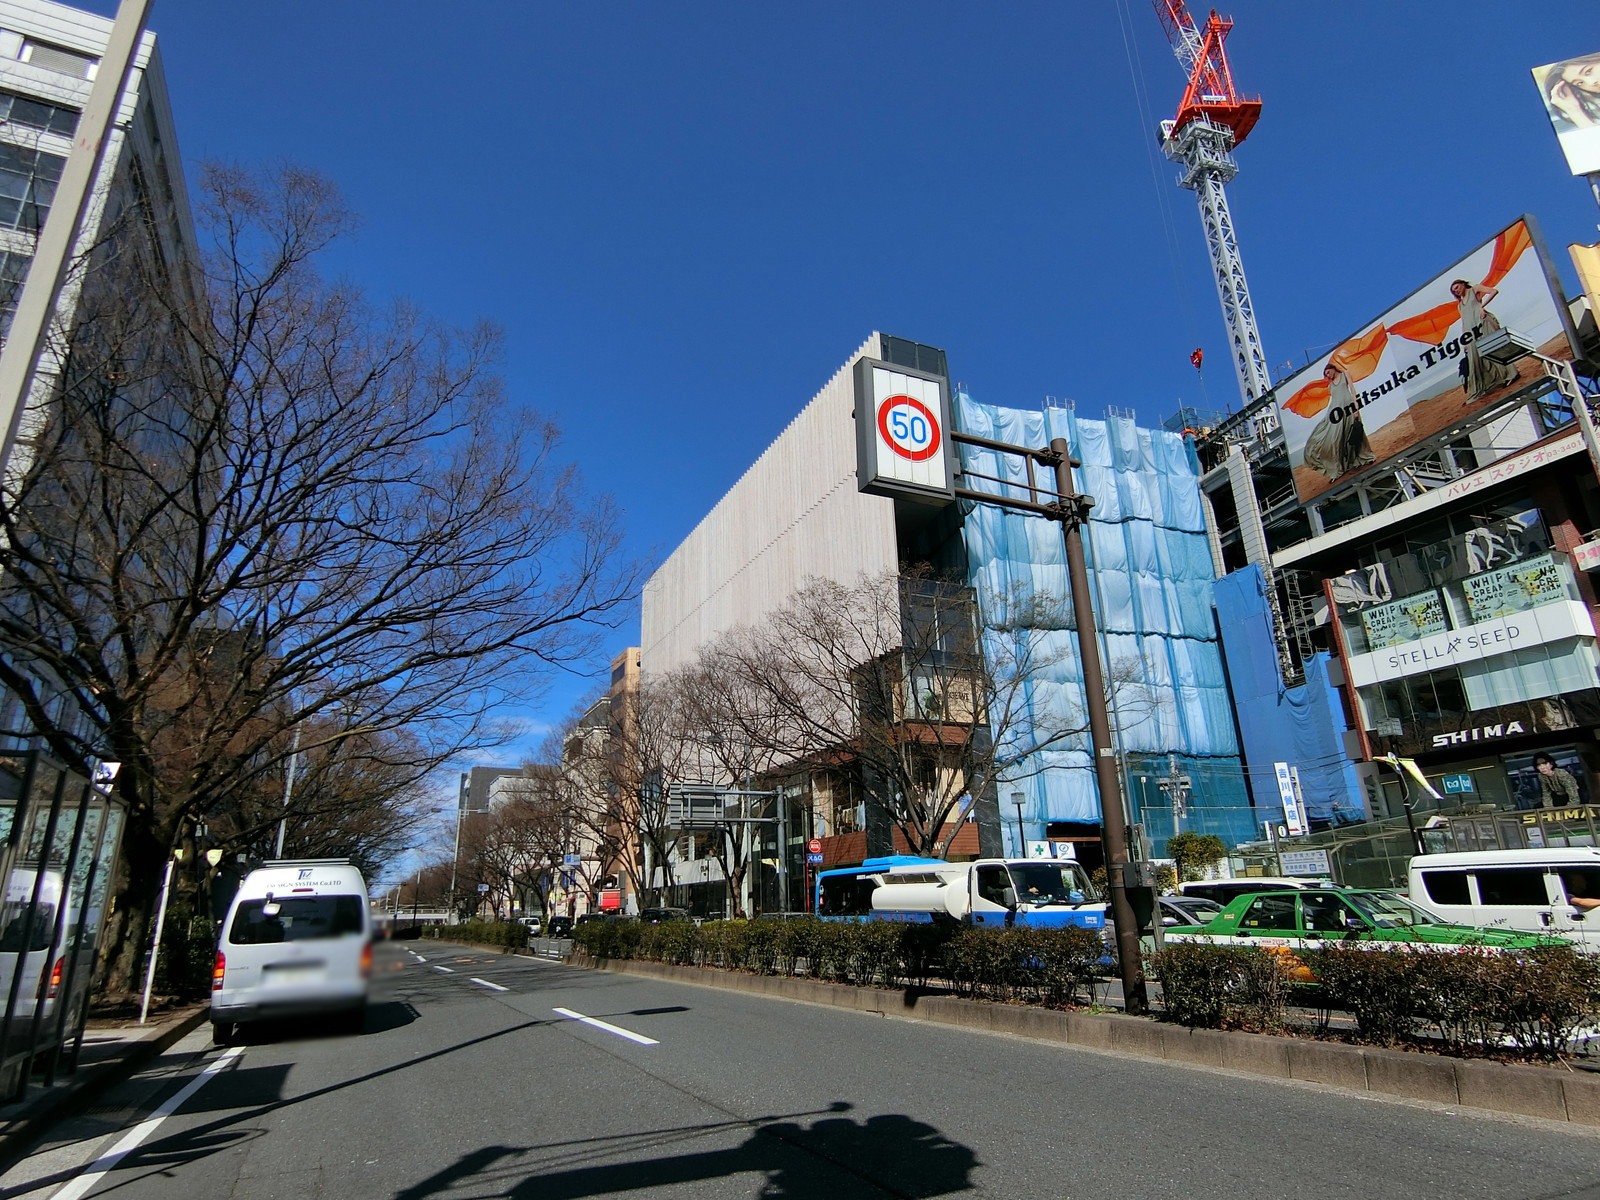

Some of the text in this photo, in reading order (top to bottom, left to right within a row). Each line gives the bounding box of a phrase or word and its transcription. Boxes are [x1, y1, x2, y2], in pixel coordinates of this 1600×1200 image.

[1329, 322, 1483, 424] Onitsuka Tiger
[892, 411, 927, 444] 50
[1448, 478, 1485, 498] バレエ
[1492, 449, 1545, 481] スタジオ
[1389, 626, 1520, 669] STELLA SEED
[1432, 720, 1525, 748] SHIMA
[1522, 808, 1597, 824] SHIMA
